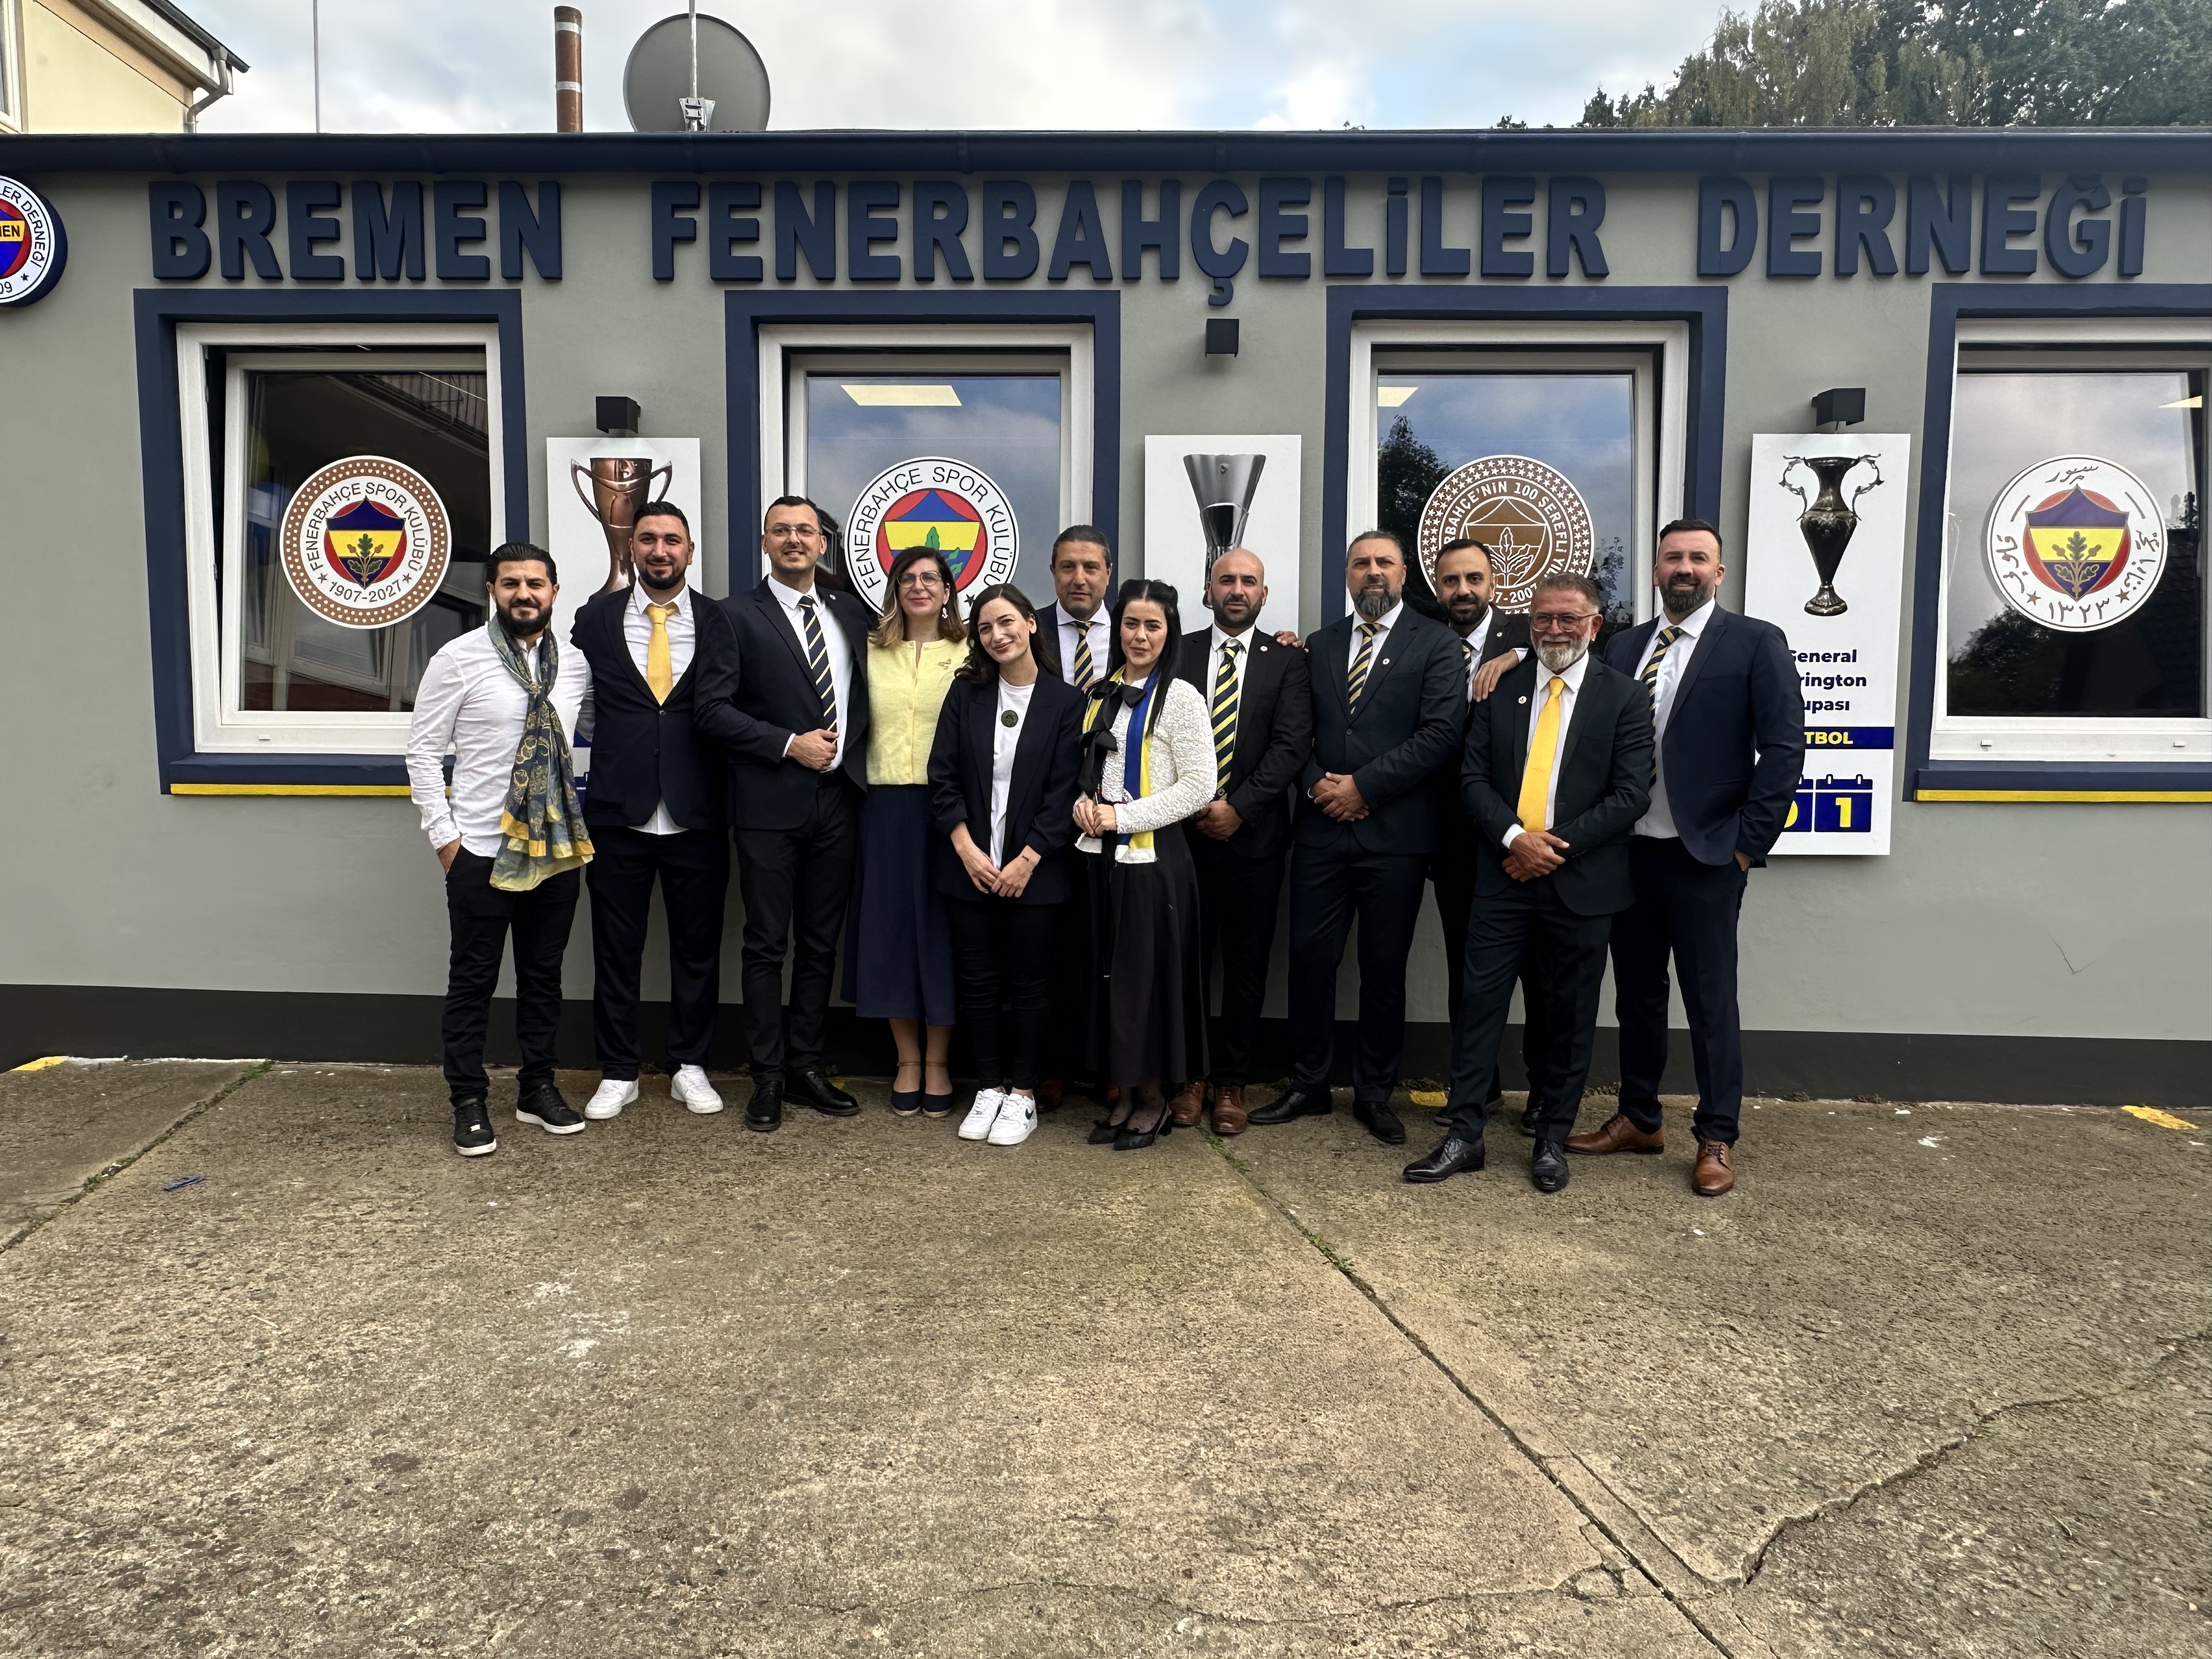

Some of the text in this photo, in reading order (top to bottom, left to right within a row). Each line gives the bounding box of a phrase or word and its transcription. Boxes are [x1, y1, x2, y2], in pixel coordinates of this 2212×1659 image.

[0, 185, 22, 204] ER
[0, 225, 20, 237] EN
[148, 174, 2148, 306] BREMEN FENERBAHÇELİLER DERNEĞİ
[1514, 482, 1538, 500] 100
[306, 482, 428, 572] FENERBAHÇE SPOR KULÜBÜ
[854, 468, 923, 589] FENERBAHÇE
[933, 467, 989, 503] SPOR
[328, 579, 402, 603] 1907-2027
[1804, 700, 1850, 714] upası
[1804, 731, 1854, 744] TBOL
